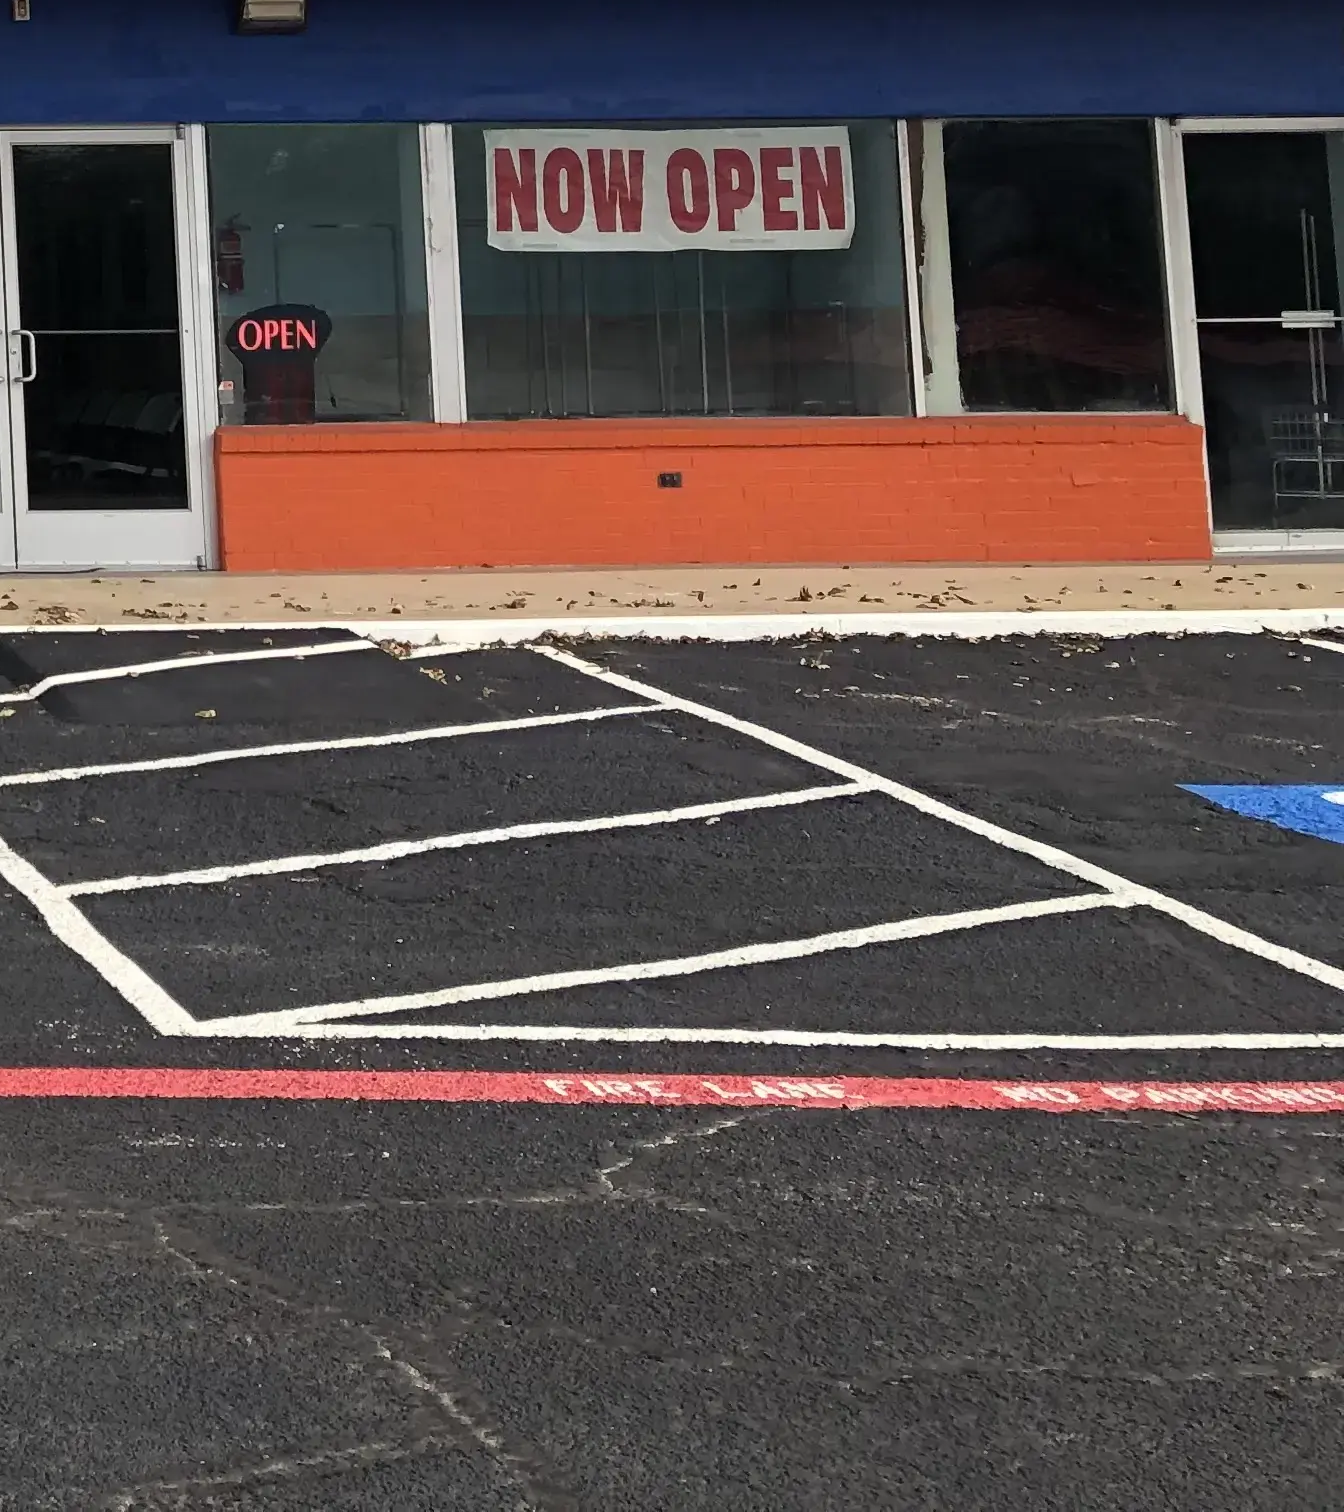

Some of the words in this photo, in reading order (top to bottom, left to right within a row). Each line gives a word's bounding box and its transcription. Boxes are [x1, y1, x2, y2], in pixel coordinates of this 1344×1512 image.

[493, 146, 646, 234] NOW
[665, 146, 846, 234] OPEN
[237, 319, 317, 351] OPEN
[543, 1079, 682, 1099] FIRE
[702, 1080, 865, 1101] LANE
[991, 1086, 1081, 1105] NO
